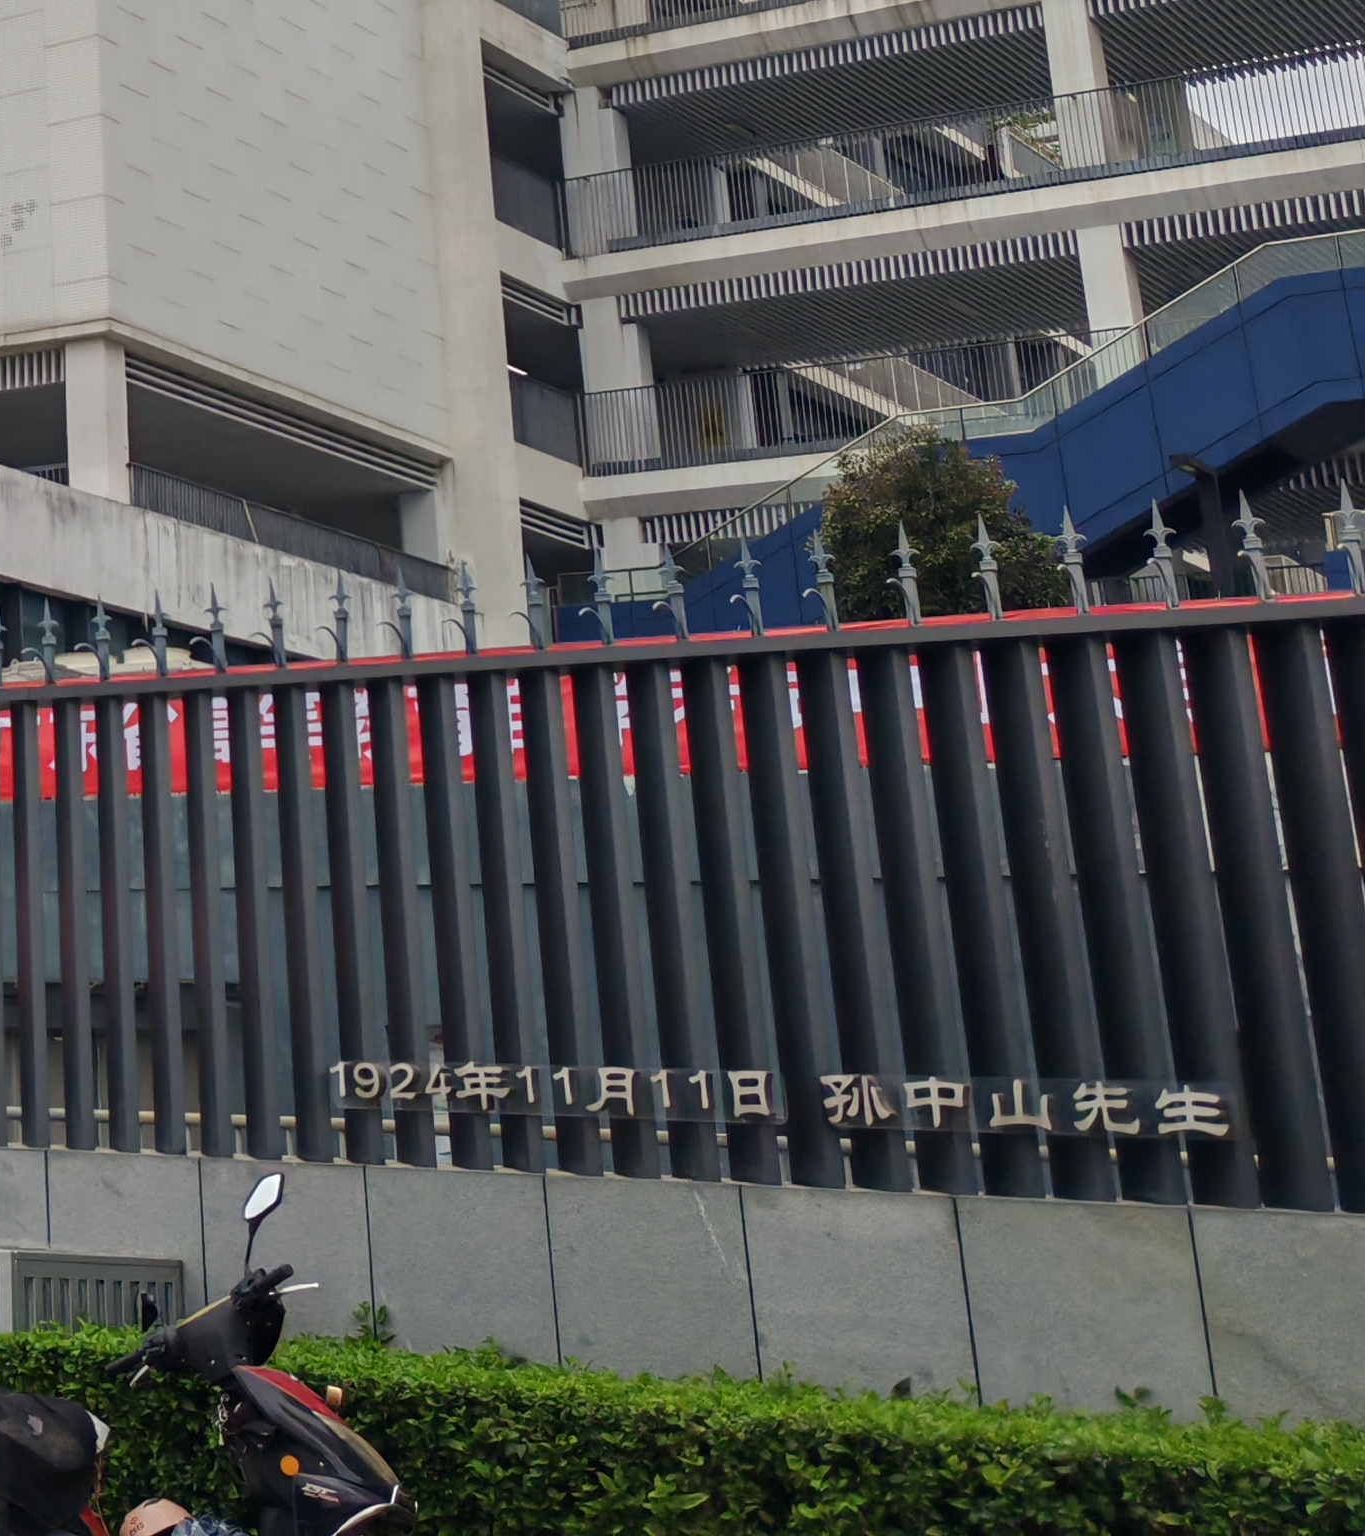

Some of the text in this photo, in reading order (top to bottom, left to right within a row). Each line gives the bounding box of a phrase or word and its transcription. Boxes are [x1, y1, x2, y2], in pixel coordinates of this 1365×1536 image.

[329, 1059, 1230, 1137] 1924年11月11日 孙中山先生
